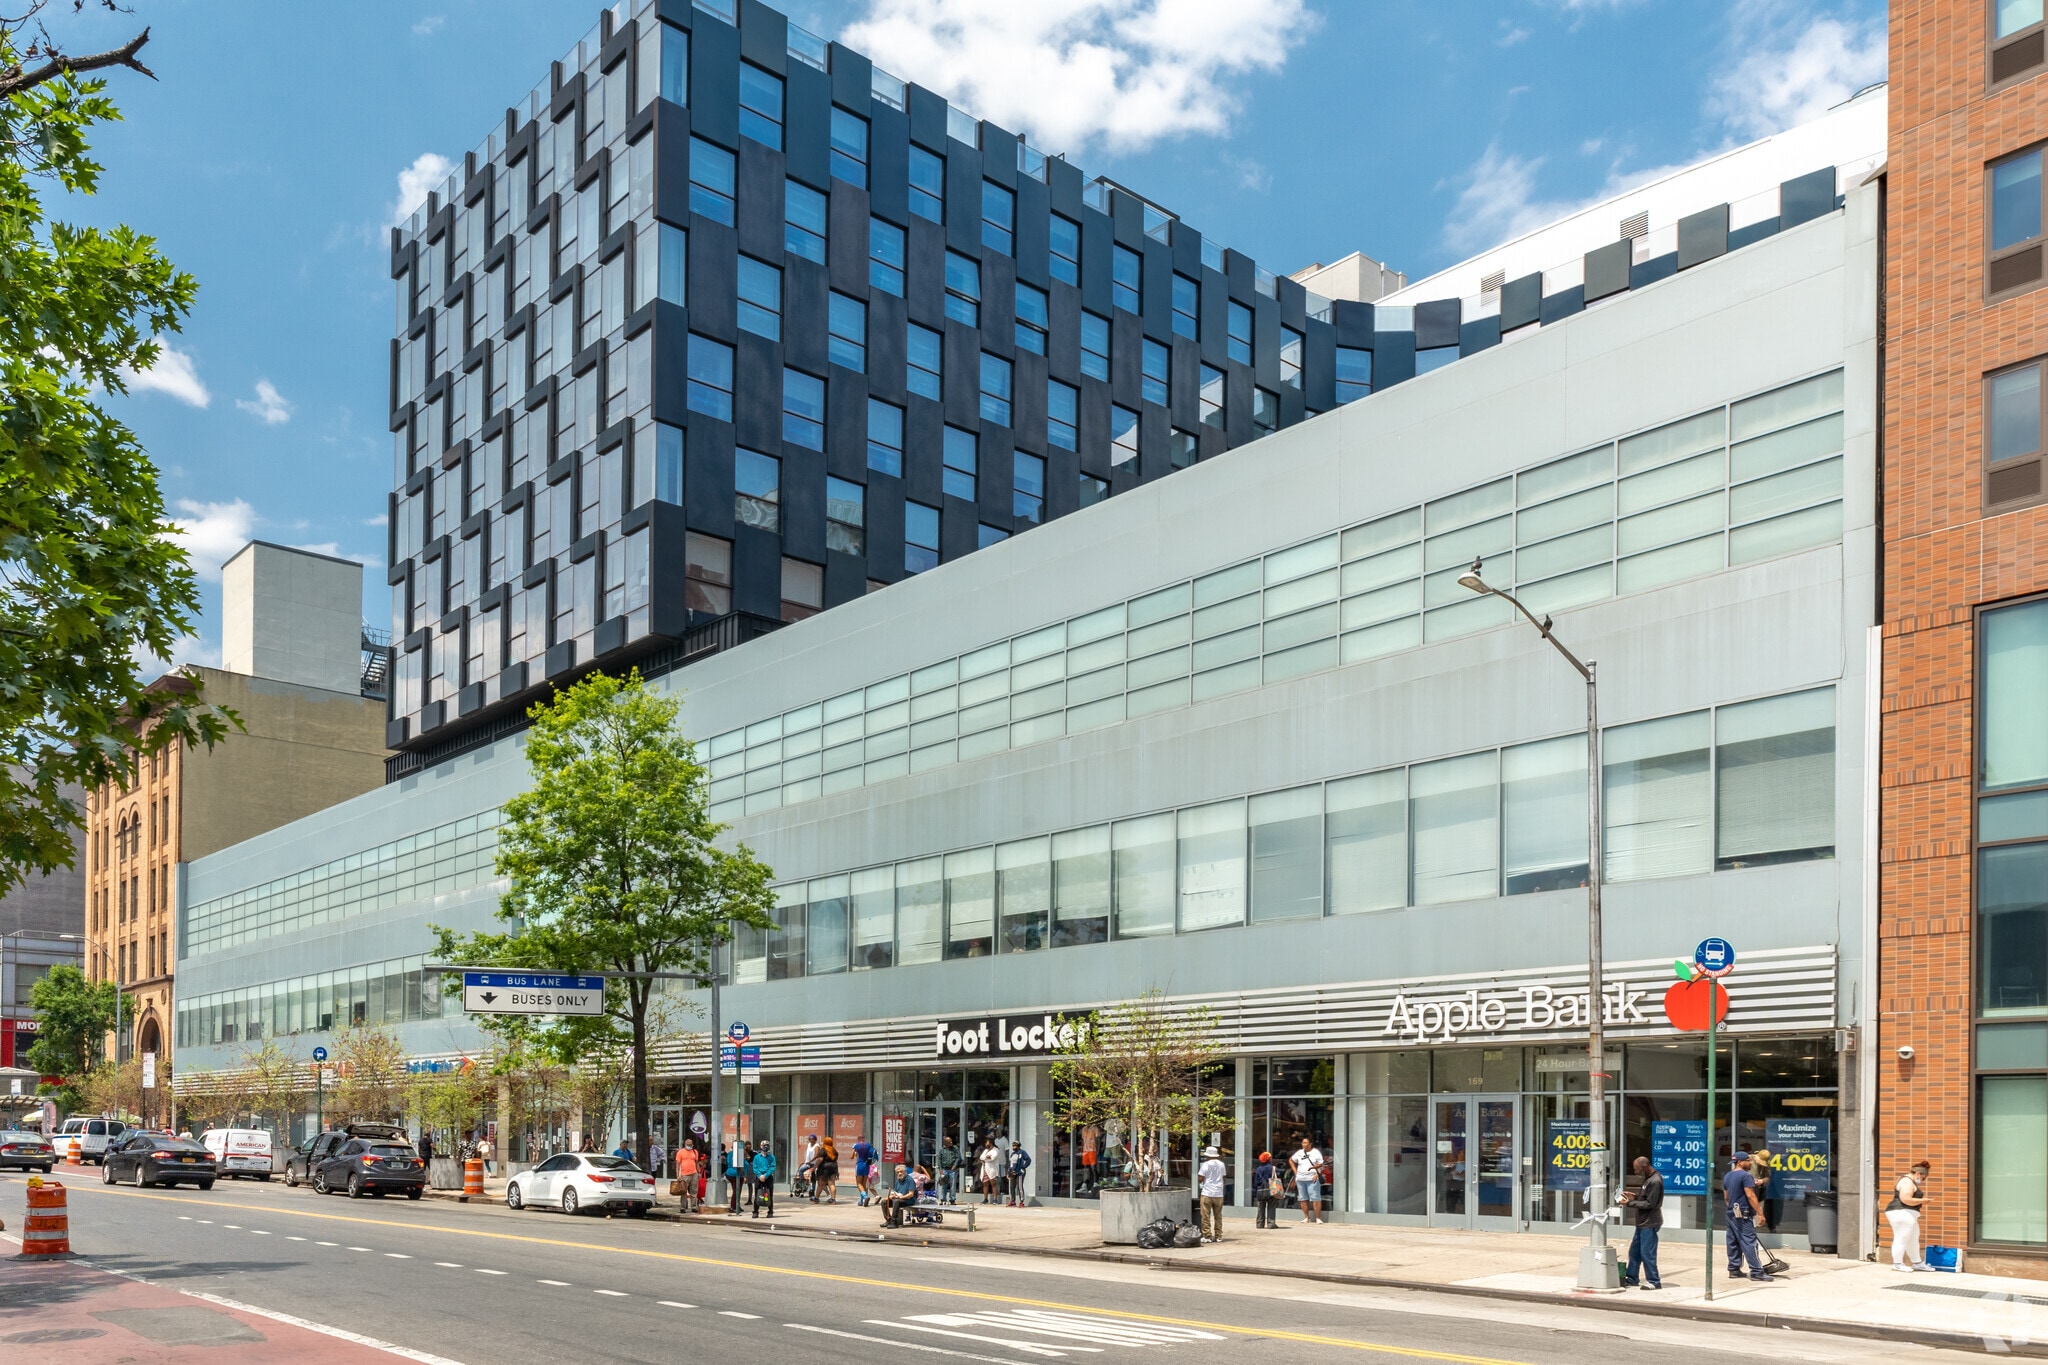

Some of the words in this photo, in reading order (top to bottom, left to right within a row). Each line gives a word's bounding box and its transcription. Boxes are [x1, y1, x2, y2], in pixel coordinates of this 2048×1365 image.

[1697, 963, 1705, 972] NO
[1704, 965, 1732, 977] STANDING
[507, 977, 527, 985] BUS
[533, 978, 561, 986] LANE
[512, 994, 552, 1005] BUSES
[557, 995, 589, 1006] ONLY
[1382, 990, 1506, 1043] Apple
[1519, 982, 1649, 1029] Bank
[937, 1022, 990, 1054] Foot
[999, 1015, 1090, 1050] Locker
[1536, 1060, 1548, 1068] 24
[1551, 1060, 1575, 1068] Hour
[1468, 1077, 1483, 1085] 169
[1481, 1108, 1504, 1117] Bank
[885, 1119, 902, 1133] BIG
[1778, 1124, 1817, 1132] Maximize
[886, 1133, 902, 1143] NIKE
[1552, 1135, 1591, 1149] 4.00%
[886, 1143, 902, 1153] SALE
[1674, 1141, 1705, 1152] 4.00%
[1552, 1153, 1591, 1168] 4.50%
[1674, 1158, 1705, 1169] 4.50%
[1769, 1154, 1828, 1172] 4.00%
[1674, 1175, 1705, 1186] 4.00%
